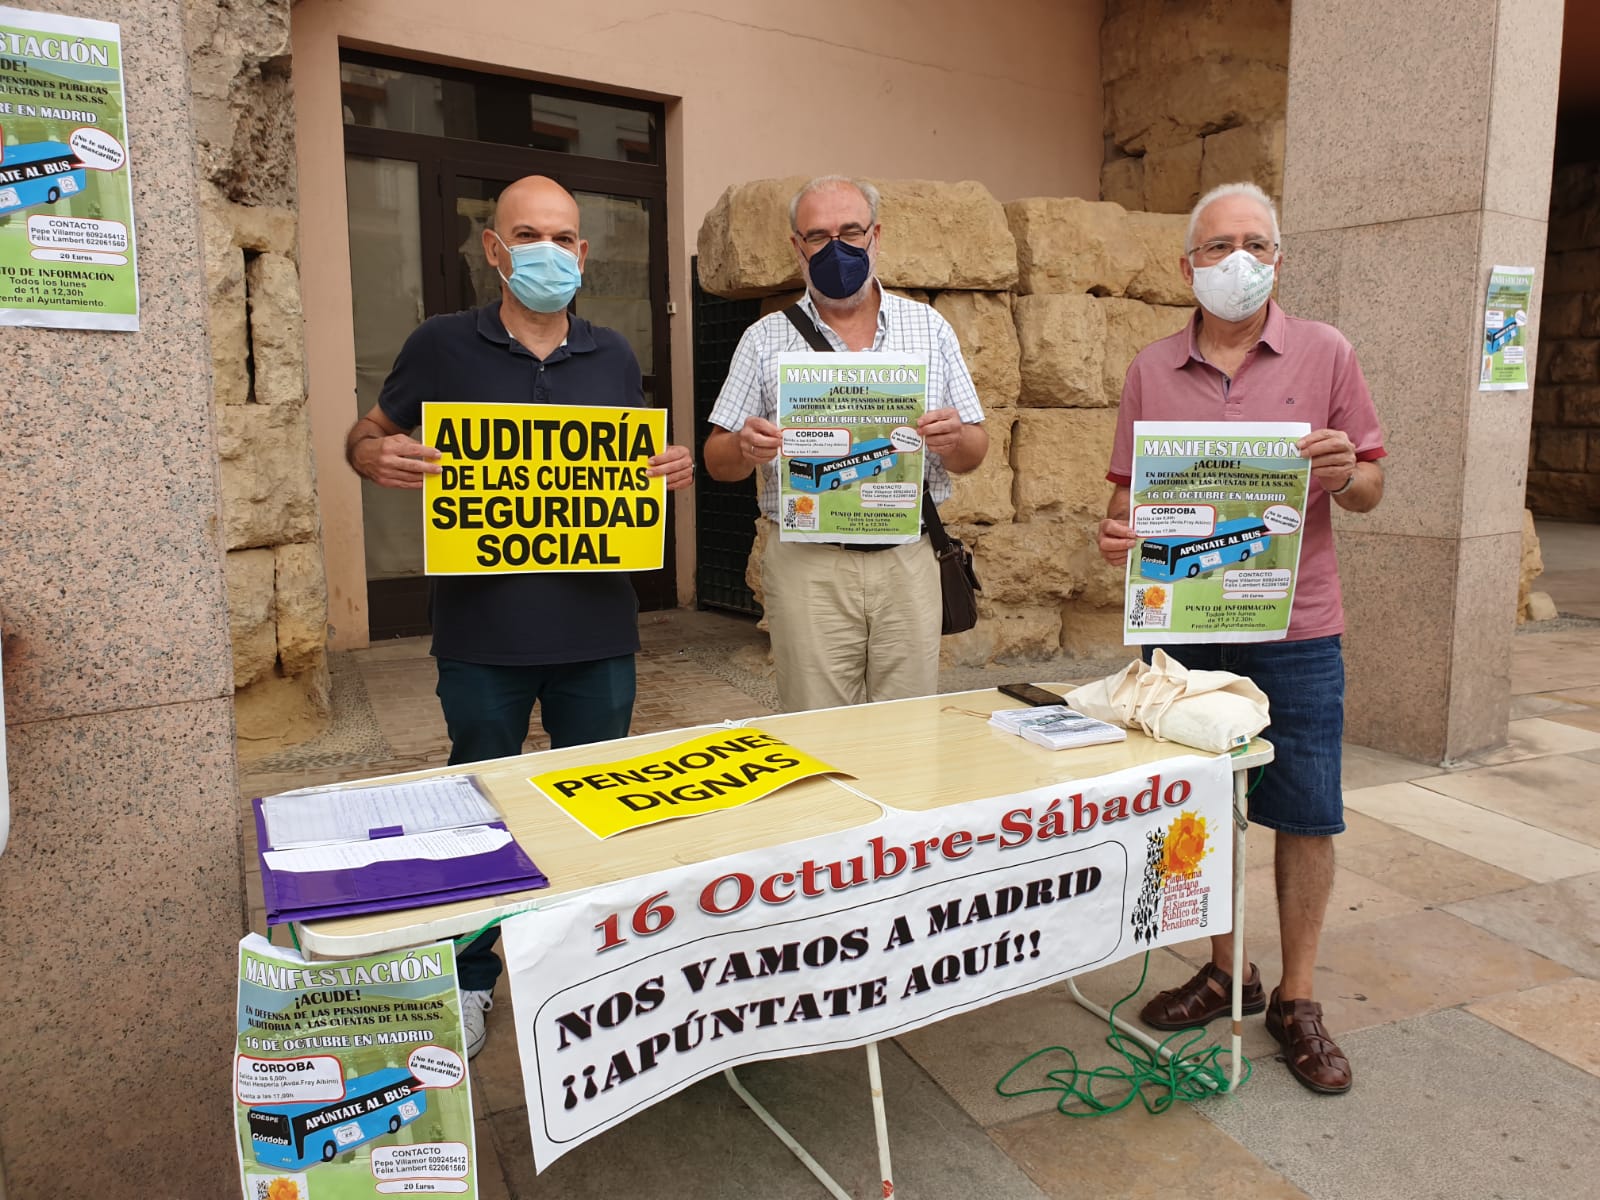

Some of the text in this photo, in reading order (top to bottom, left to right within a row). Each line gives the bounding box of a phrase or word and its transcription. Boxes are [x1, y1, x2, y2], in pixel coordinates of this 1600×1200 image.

[44, 91, 57, 99] DE
[61, 92, 72, 101] LA
[75, 95, 107, 105] SS.SS.
[17, 104, 36, 116] EN
[40, 106, 97, 123] MADRID
[81, 144, 120, 164] mascarilla!
[98, 143, 121, 157] olvides
[26, 167, 43, 178] AL
[44, 160, 71, 174] BUS
[49, 220, 99, 230] CONTACTO
[31, 228, 50, 237] Pepe
[53, 229, 83, 237] Villamor
[53, 236, 84, 245] Lambert
[20, 268, 35, 276] DE
[10, 277, 39, 285] Todos
[61, 280, 87, 288] lunes
[787, 365, 919, 383] MANIFESTACIÓN
[830, 386, 869, 396] ¡ACUDE!
[819, 416, 857, 424] OCTUBRE
[875, 416, 908, 424] MADRID
[435, 413, 656, 462] AUDITORÍA
[862, 453, 872, 461] AL
[874, 449, 889, 459] BUS
[1194, 460, 1241, 471] ¡ACUDE!
[441, 466, 650, 490] DE LAS CUENTAS
[1147, 491, 1159, 499] 16
[1180, 492, 1225, 500] OCTUBRE
[1229, 492, 1241, 500] EN
[1245, 493, 1286, 502] MADRID
[432, 496, 659, 529] SEGURIDAD
[1180, 530, 1261, 556] APÚNTATE AL BUS
[477, 534, 620, 567] SOCIAL
[553, 733, 790, 798] PENSIONES
[616, 752, 800, 812] DIGNAS
[594, 773, 1192, 954] 16 Octubre-Sábado
[1173, 899, 1197, 909] Sistema
[1192, 907, 1199, 915] de
[1162, 917, 1199, 932] Pensiones
[553, 865, 1102, 1052] NOS VAMOS A MADRID
[245, 952, 442, 991] MANIFESTACIÓN
[295, 989, 361, 1009] ¡ACUDE!
[255, 1008, 290, 1020] DEFENSA
[294, 1011, 309, 1019] DE
[312, 1008, 330, 1017] LAS
[334, 1004, 390, 1015] PENSIONES
[308, 1019, 327, 1028] LAS
[330, 1016, 374, 1026] CUENTAS
[379, 1015, 392, 1023] DE
[396, 1014, 408, 1022] LA
[411, 1012, 443, 1021] SS.SS.
[560, 929, 1042, 1111] ¡¡APÚNTATE AQUÍ!!
[246, 1030, 434, 1051] 16 DE OCTUBRE EN MADRID
[252, 1061, 315, 1072] CORDOBA
[420, 1064, 459, 1078] mascarilla!
[437, 1060, 461, 1071] olvides
[305, 1086, 411, 1130] APÚNTATE AL BUS
[250, 1113, 278, 1123] COESPE
[252, 1133, 288, 1145] Córdoba
[392, 1148, 441, 1157] CONTACTO
[395, 1158, 426, 1166] Villamor
